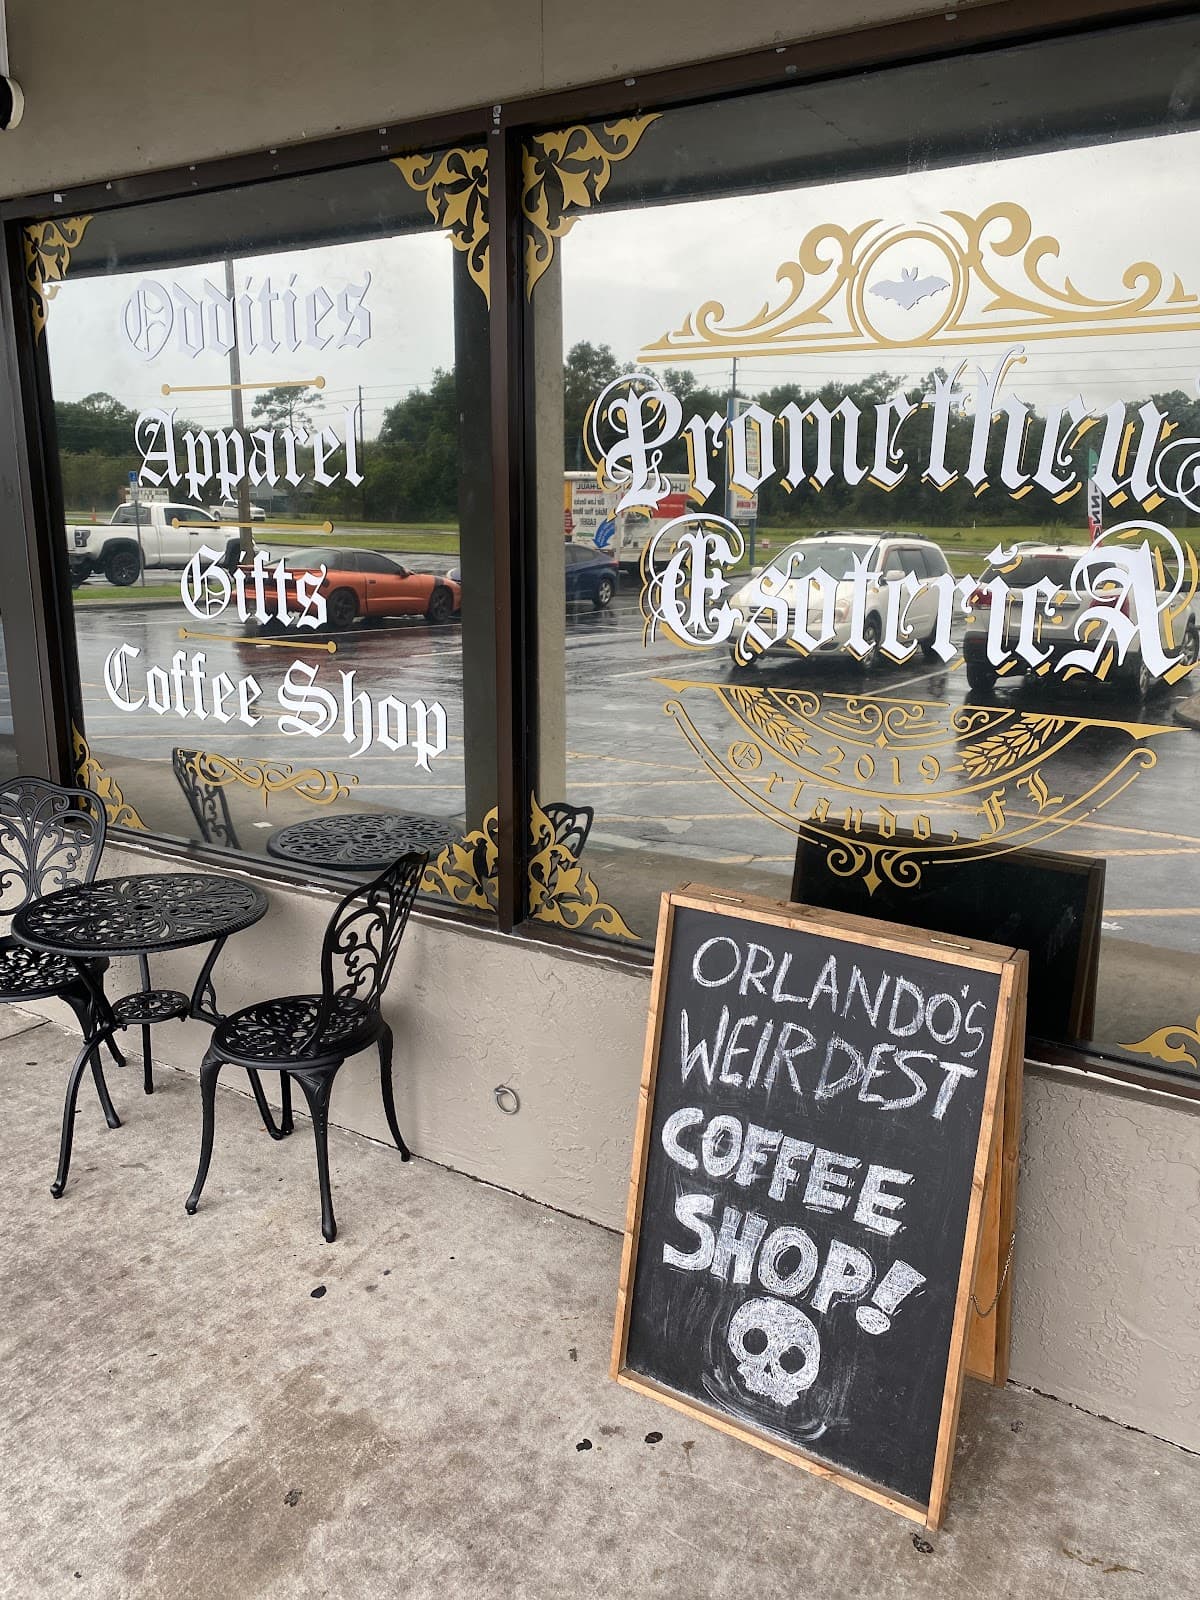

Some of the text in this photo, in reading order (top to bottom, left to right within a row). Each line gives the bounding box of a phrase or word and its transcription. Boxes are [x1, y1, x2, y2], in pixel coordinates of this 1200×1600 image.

[120, 270, 372, 362] Oddities
[134, 403, 365, 501] Apparel
[592, 344, 1200, 513] Prometheu
[180, 544, 328, 629] Gifts
[103, 643, 448, 773] Coffee Shop
[820, 745, 941, 785] 2019
[692, 936, 987, 1058] ORLANDO'S
[680, 1004, 978, 1121] WEIRDEST
[661, 1107, 915, 1237] COFFEE
[662, 1194, 928, 1336] SHOP!
